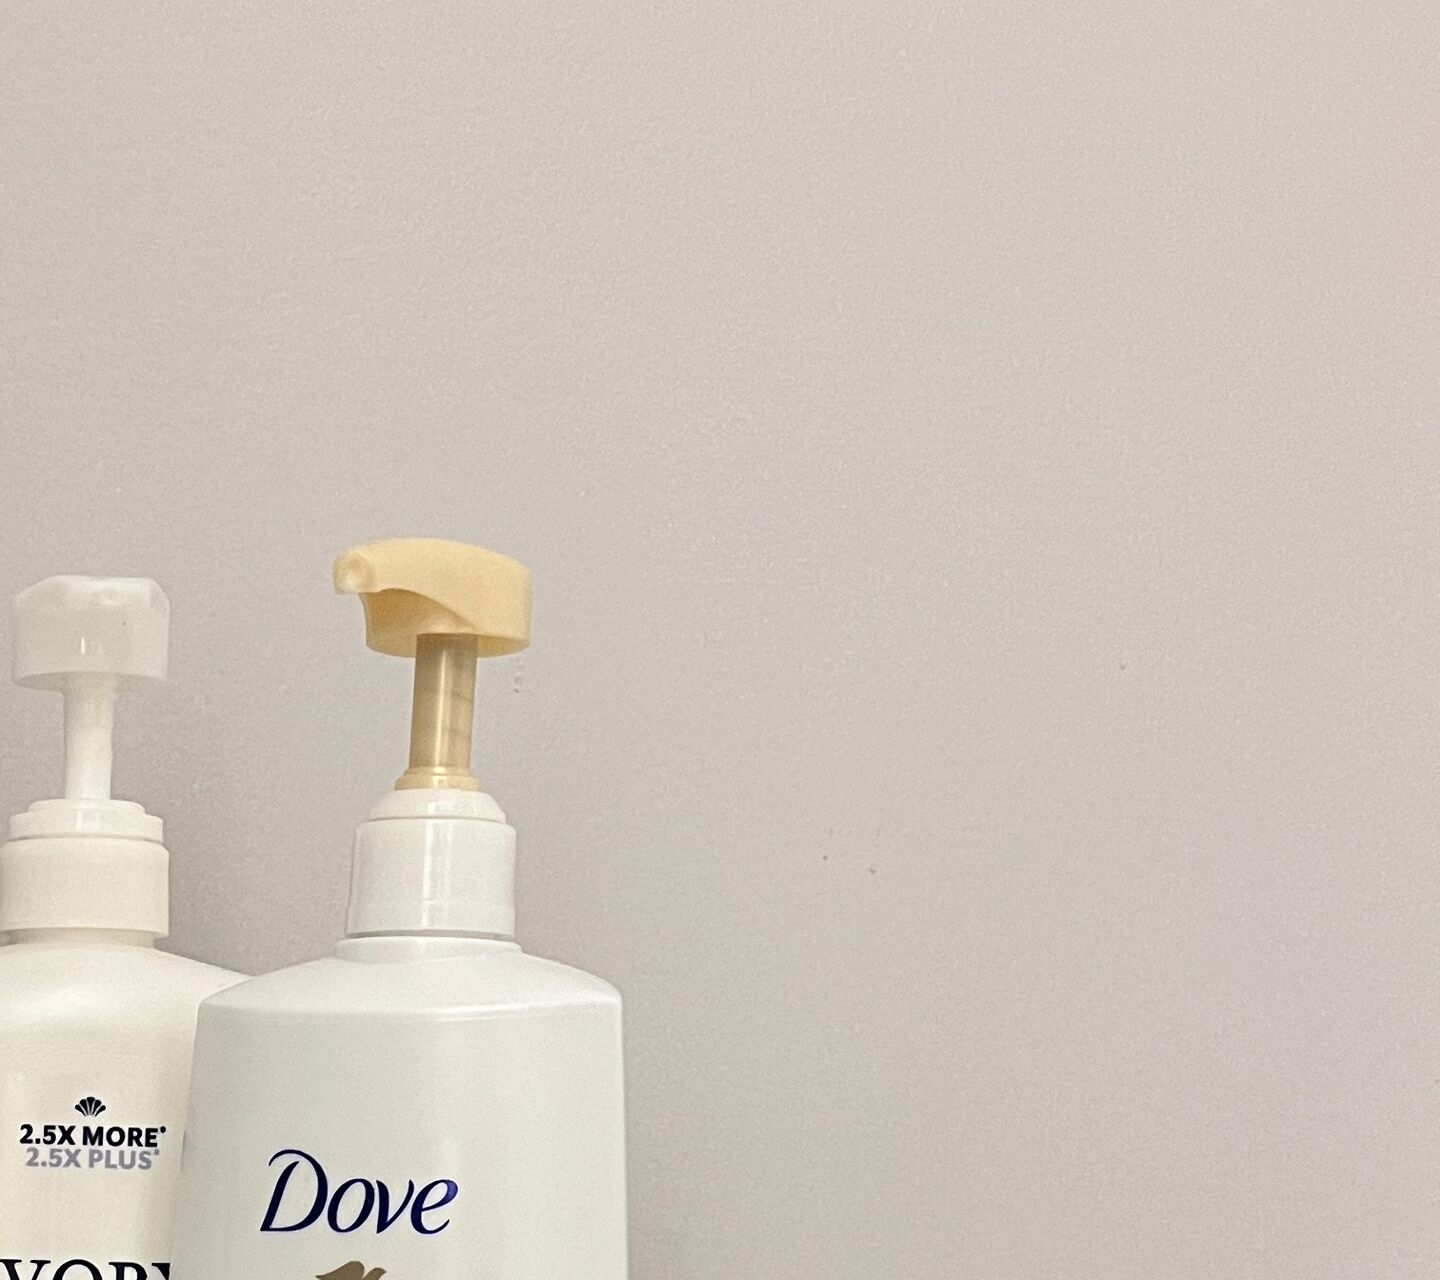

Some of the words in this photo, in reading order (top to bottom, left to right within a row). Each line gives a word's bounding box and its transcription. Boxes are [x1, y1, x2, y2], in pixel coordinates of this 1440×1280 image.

[19, 1124, 76, 1145] 2.5X
[26, 1147, 81, 1168] 2.5X
[260, 1149, 458, 1234] Dove
